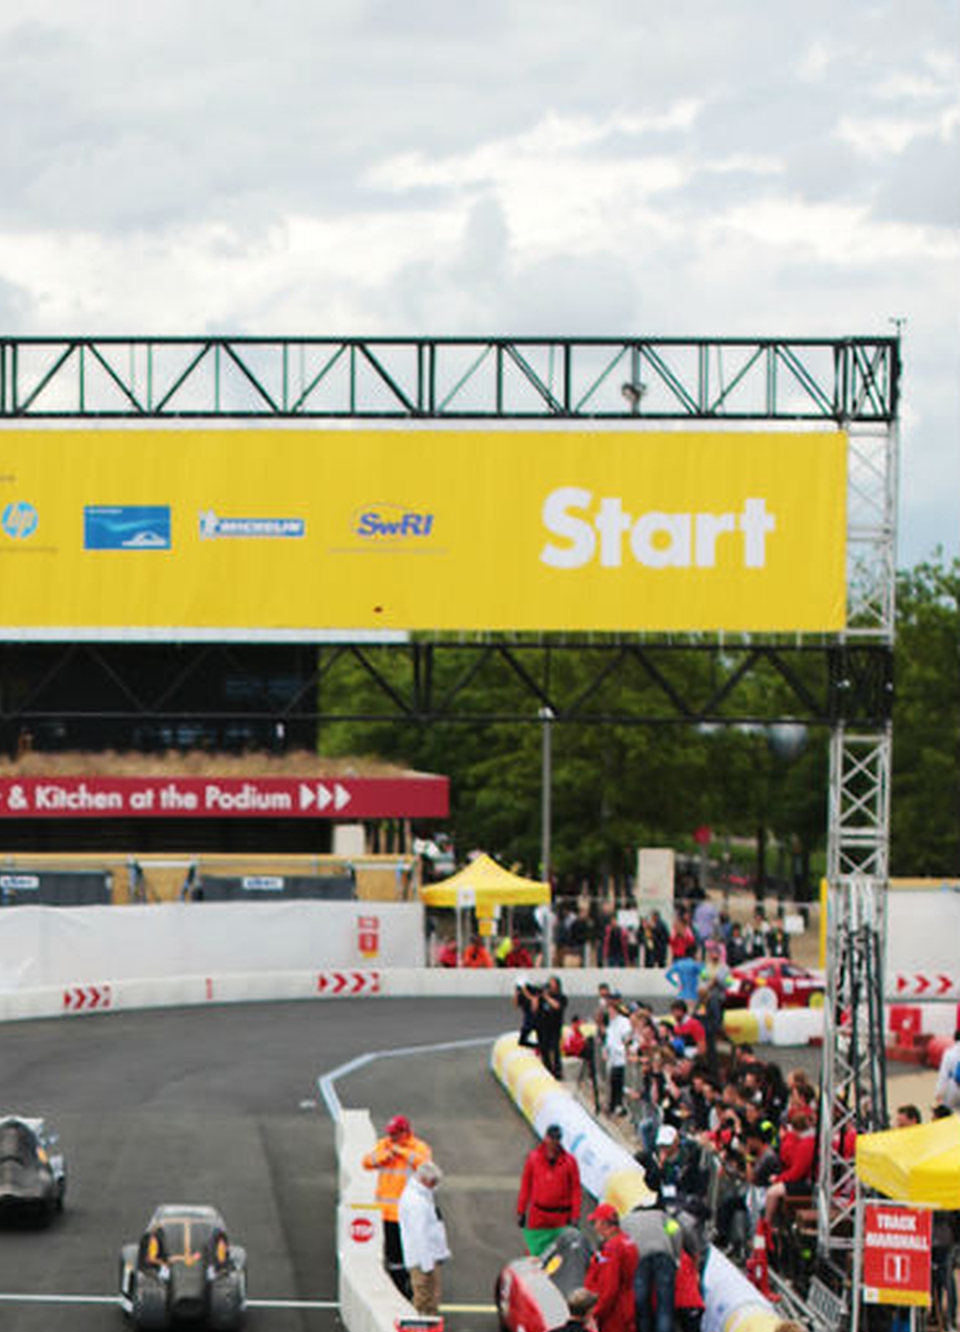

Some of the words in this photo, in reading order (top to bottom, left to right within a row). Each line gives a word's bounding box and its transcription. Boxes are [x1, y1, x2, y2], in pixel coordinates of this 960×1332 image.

[358, 513, 434, 535] SwRI
[540, 486, 775, 568] Start
[7, 785, 28, 809] &
[35, 784, 123, 809] Kitchen
[130, 788, 154, 809] at
[160, 784, 198, 809] the
[205, 784, 292, 809] Podium
[877, 1214, 916, 1231] TRACK
[866, 1231, 928, 1250] MARSHALL
